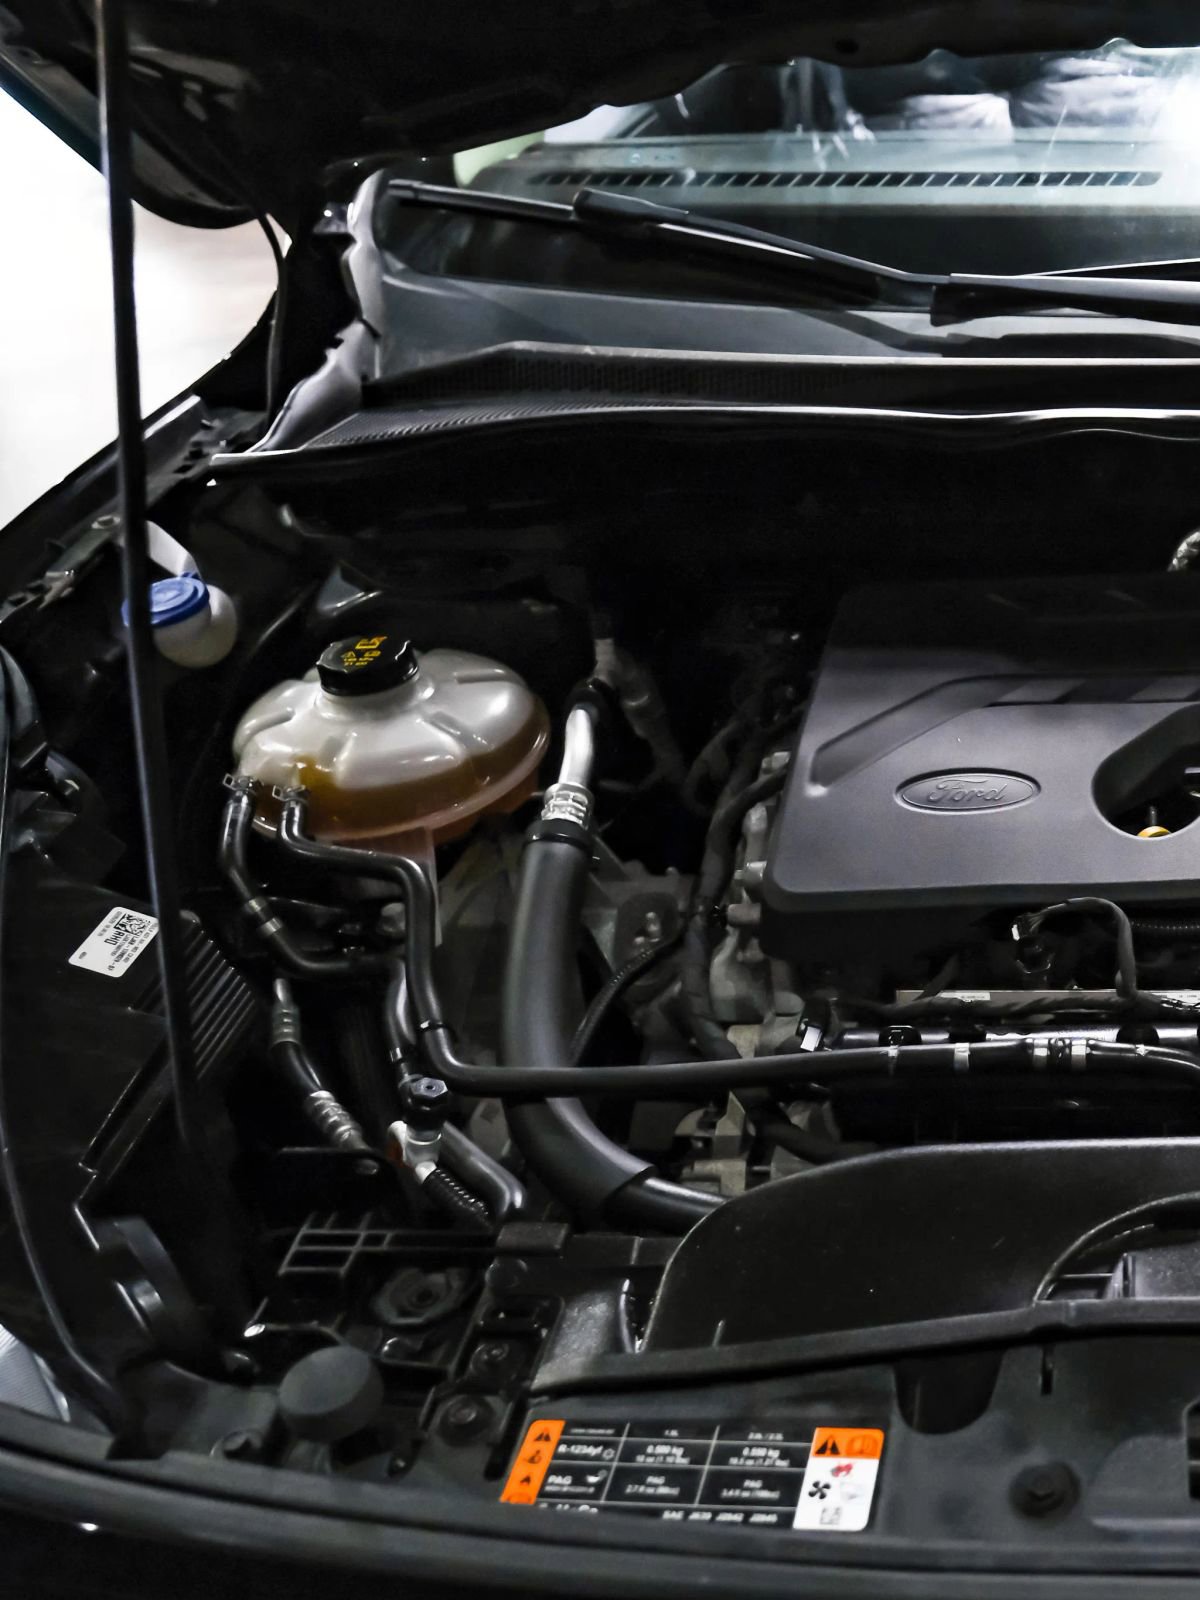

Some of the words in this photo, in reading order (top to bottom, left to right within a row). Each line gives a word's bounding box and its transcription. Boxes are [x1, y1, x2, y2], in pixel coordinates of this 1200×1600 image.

[926, 779, 1008, 804] Ford
[104, 931, 125, 946] RHD
[558, 1444, 604, 1457] R-1234yf
[547, 1474, 573, 1486] PAG
[662, 1510, 685, 1521] SAE
